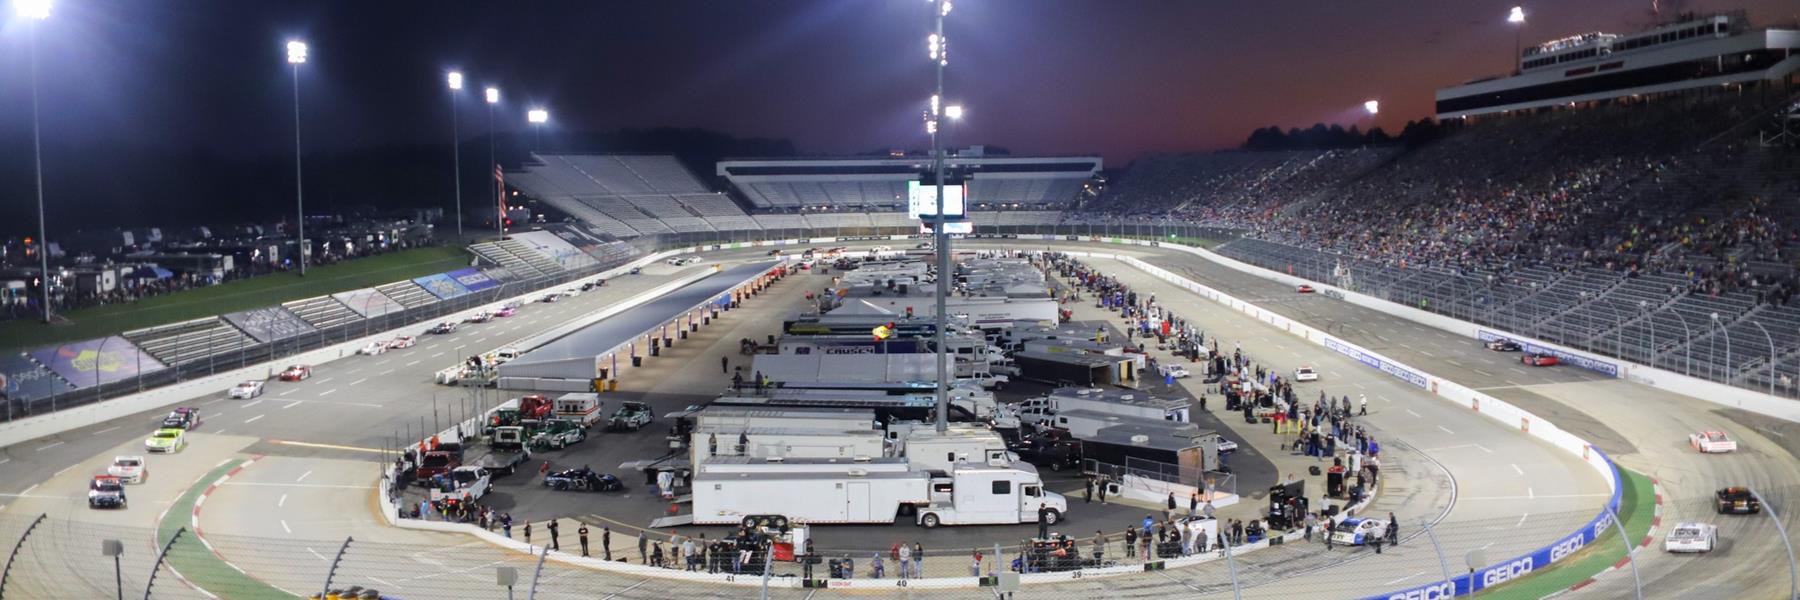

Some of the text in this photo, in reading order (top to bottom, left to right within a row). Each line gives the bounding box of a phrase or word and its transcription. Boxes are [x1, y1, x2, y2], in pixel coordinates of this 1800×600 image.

[1550, 533, 1584, 563] GEICO
[1072, 571, 1081, 579] 39
[1483, 557, 1533, 588] GEICO
[726, 575, 735, 583] 41
[896, 580, 908, 588] 40
